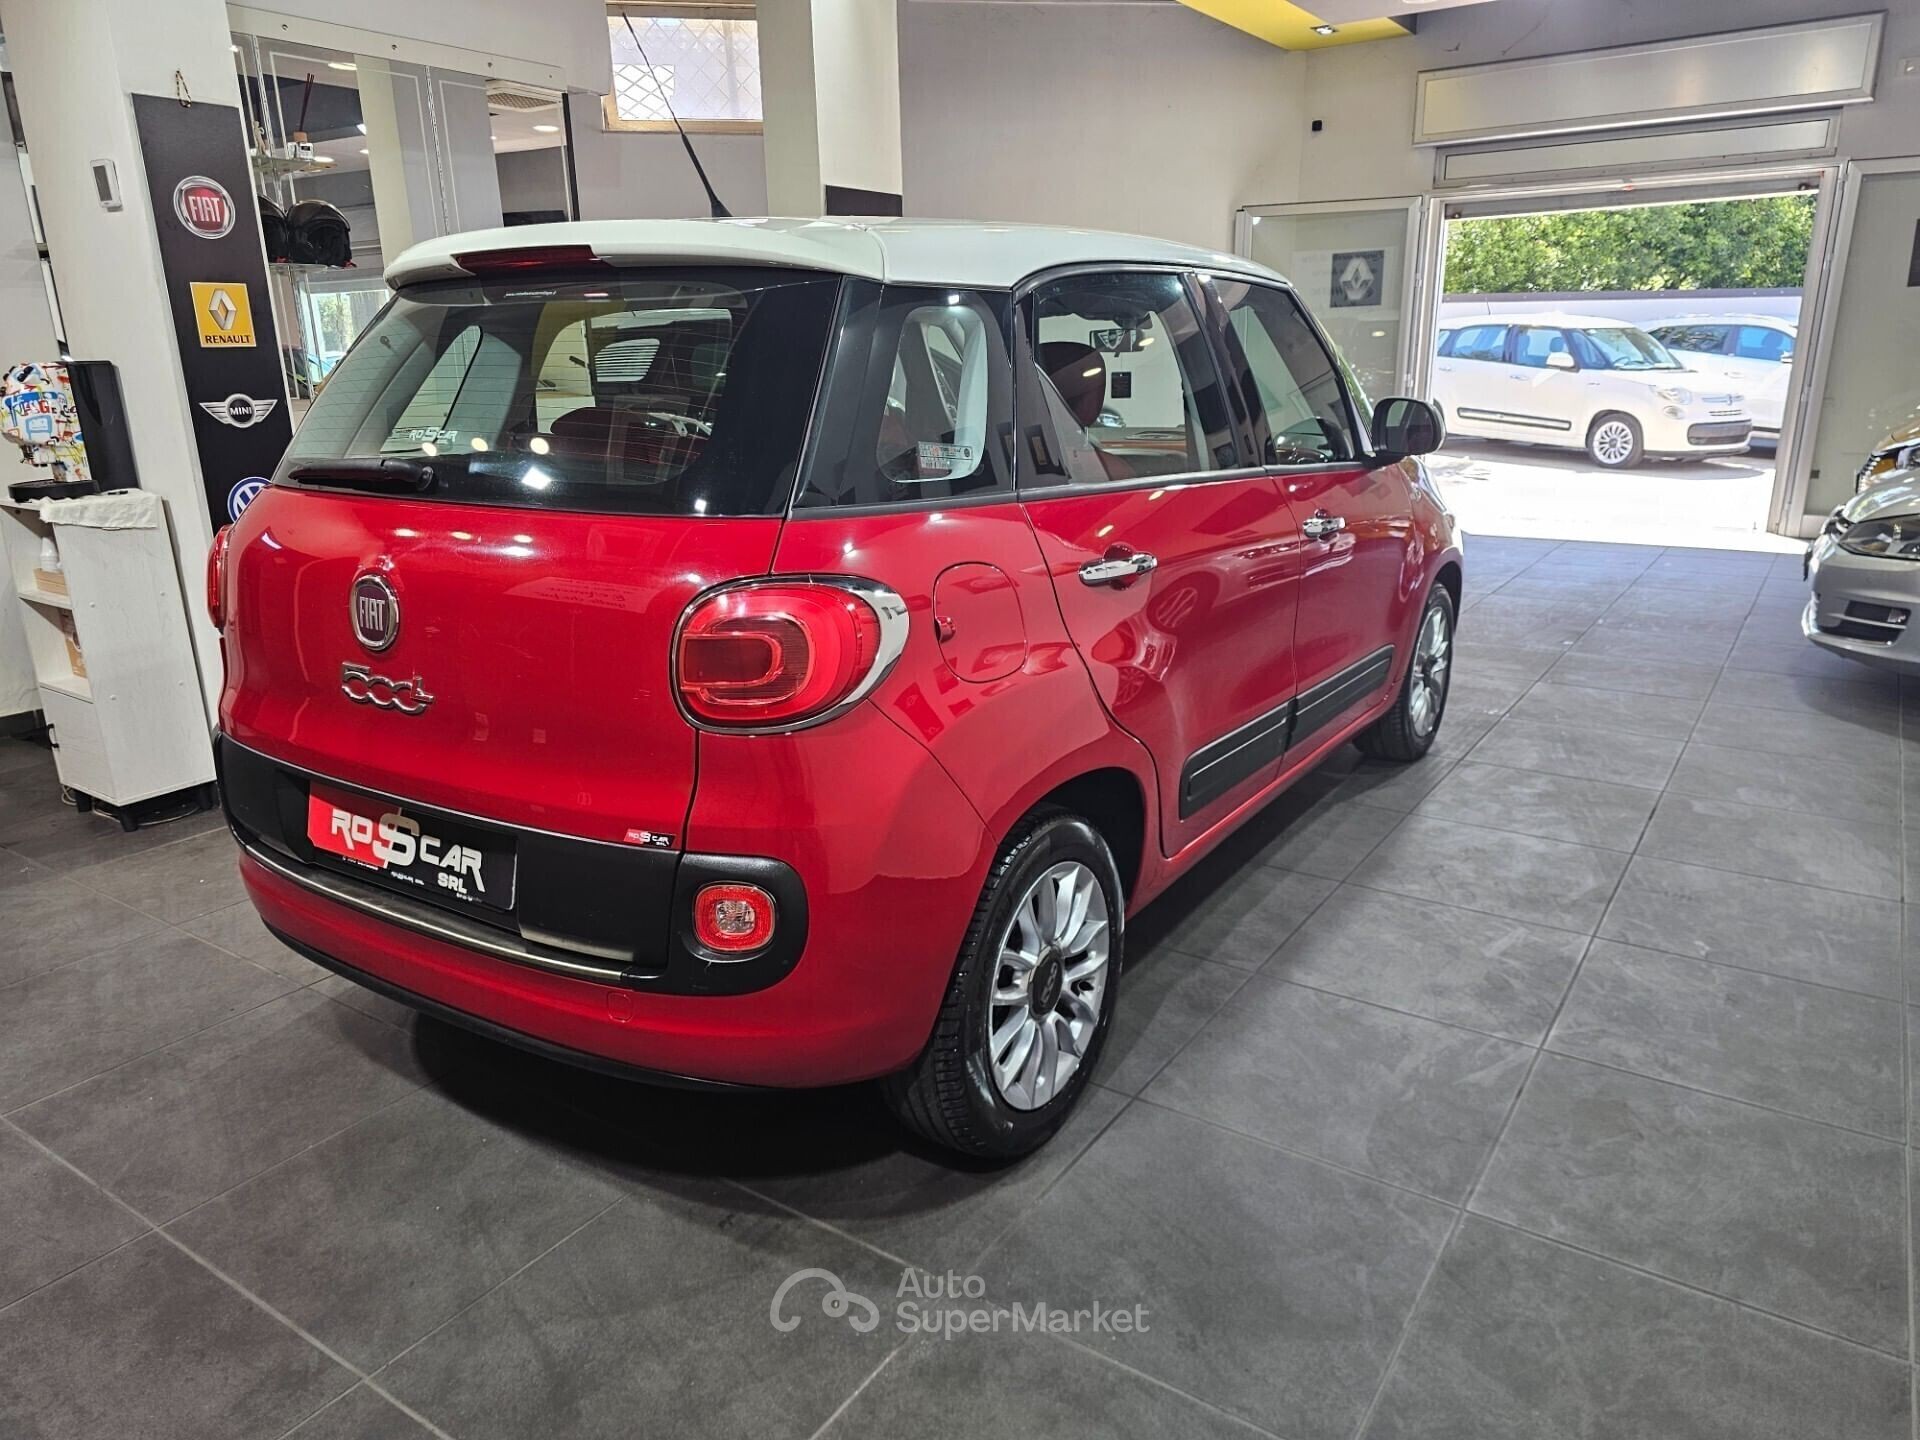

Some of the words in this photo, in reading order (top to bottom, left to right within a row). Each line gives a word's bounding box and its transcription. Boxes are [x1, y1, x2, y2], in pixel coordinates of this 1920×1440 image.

[188, 195, 221, 222] FIAT
[205, 335, 251, 344] RENAULT
[229, 406, 253, 416] MINI
[359, 596, 386, 632] FIAT
[437, 872, 468, 895] SRL
